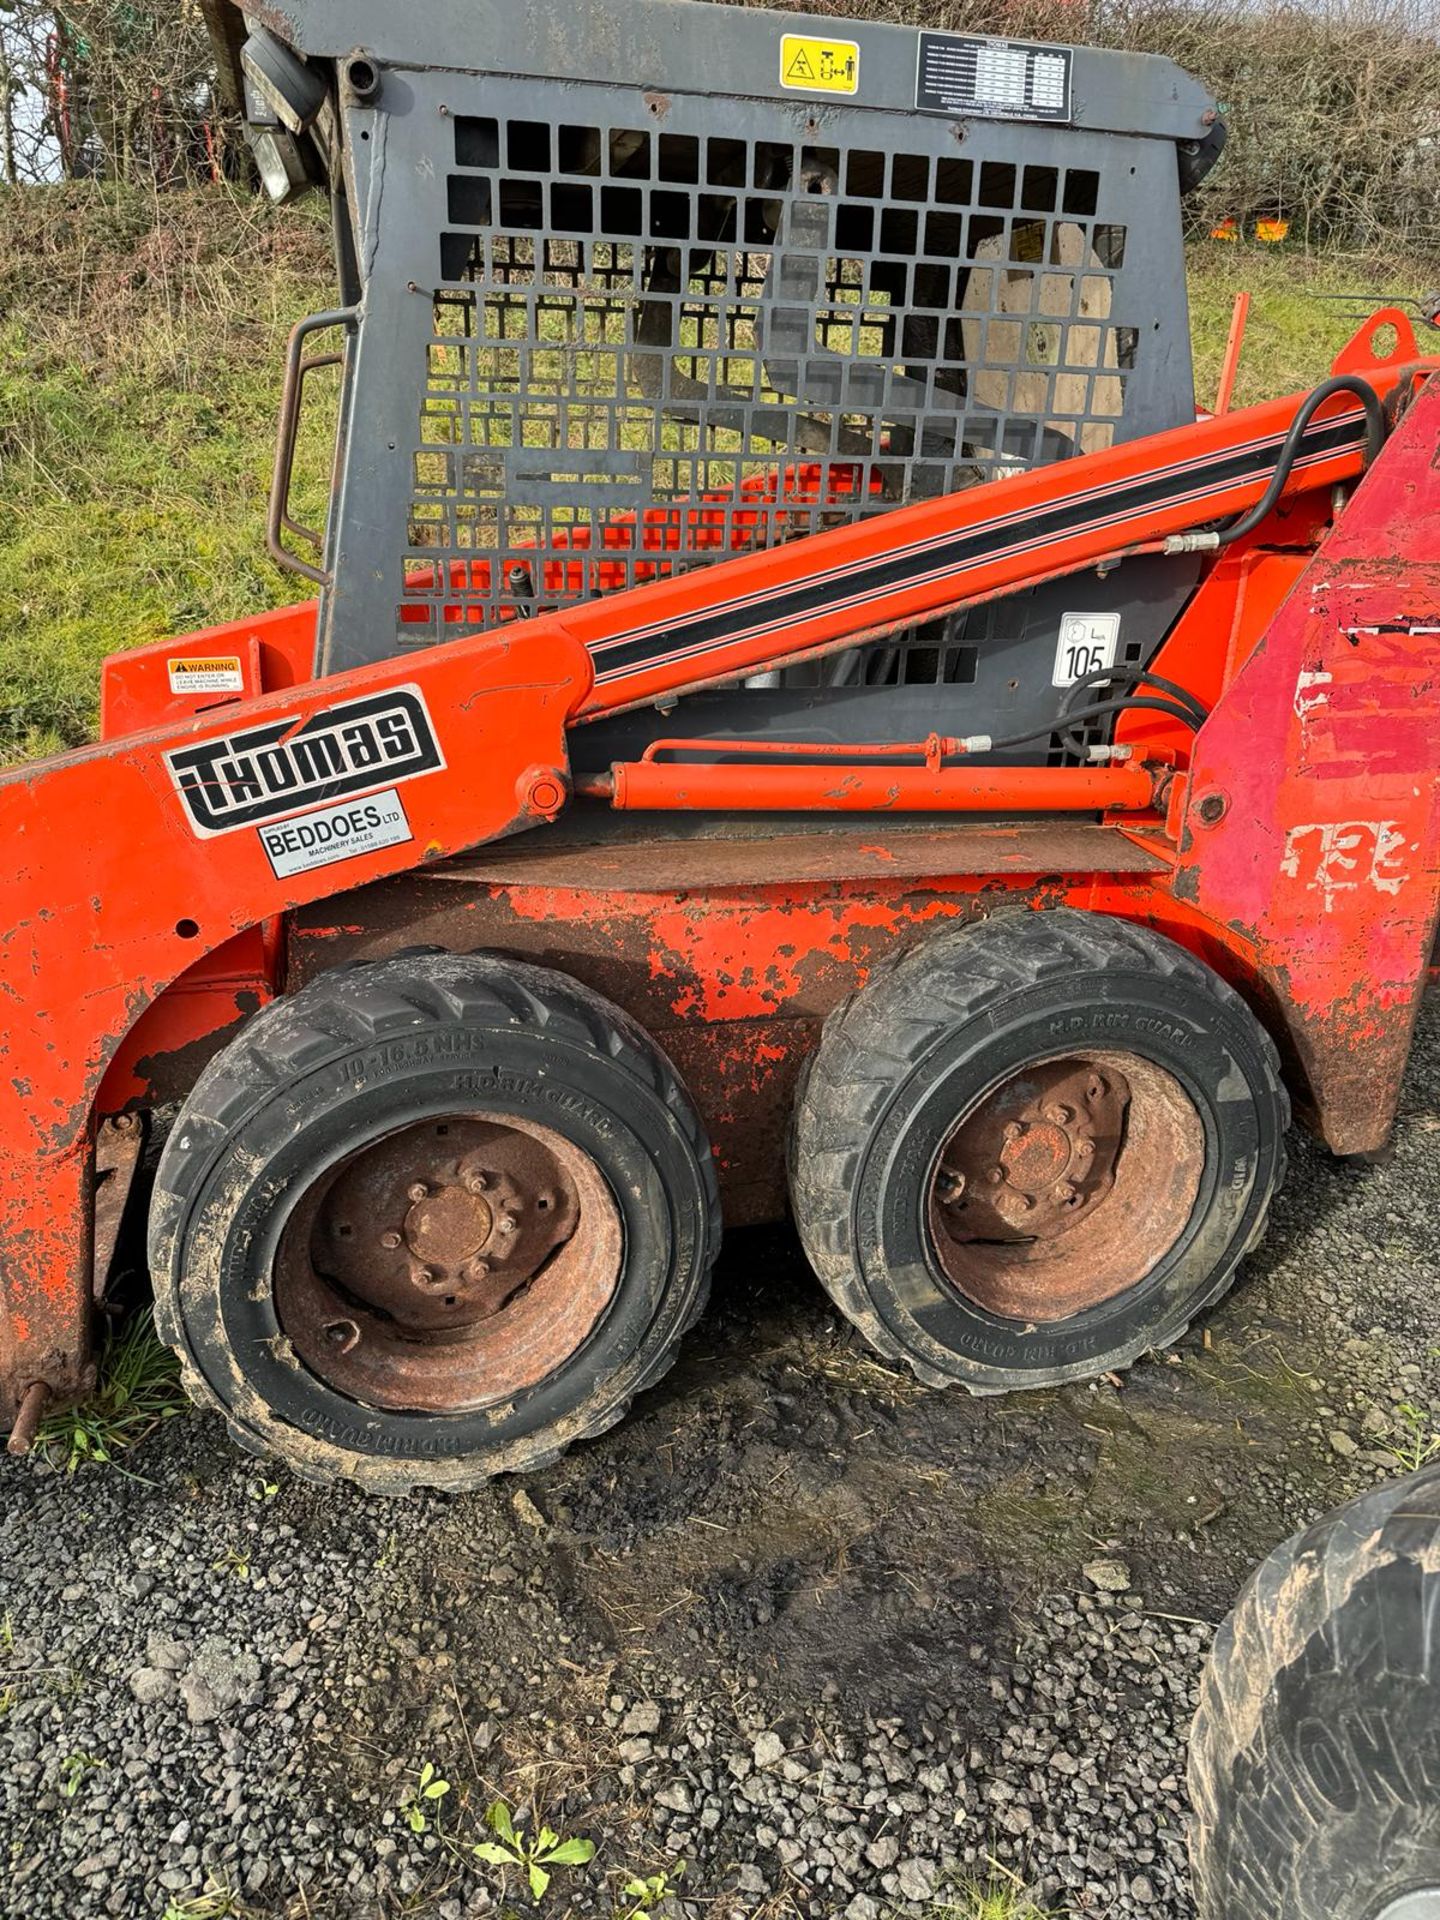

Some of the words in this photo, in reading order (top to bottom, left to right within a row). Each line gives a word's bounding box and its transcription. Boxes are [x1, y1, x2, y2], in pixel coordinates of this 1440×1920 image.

[187, 662, 235, 673] WARNING
[1066, 645, 1105, 679] 105
[264, 804, 383, 858] BEDDOES
[307, 839, 350, 857] MACHINERY
[349, 831, 374, 844] SALES
[1092, 1013, 1130, 1028] RIM
